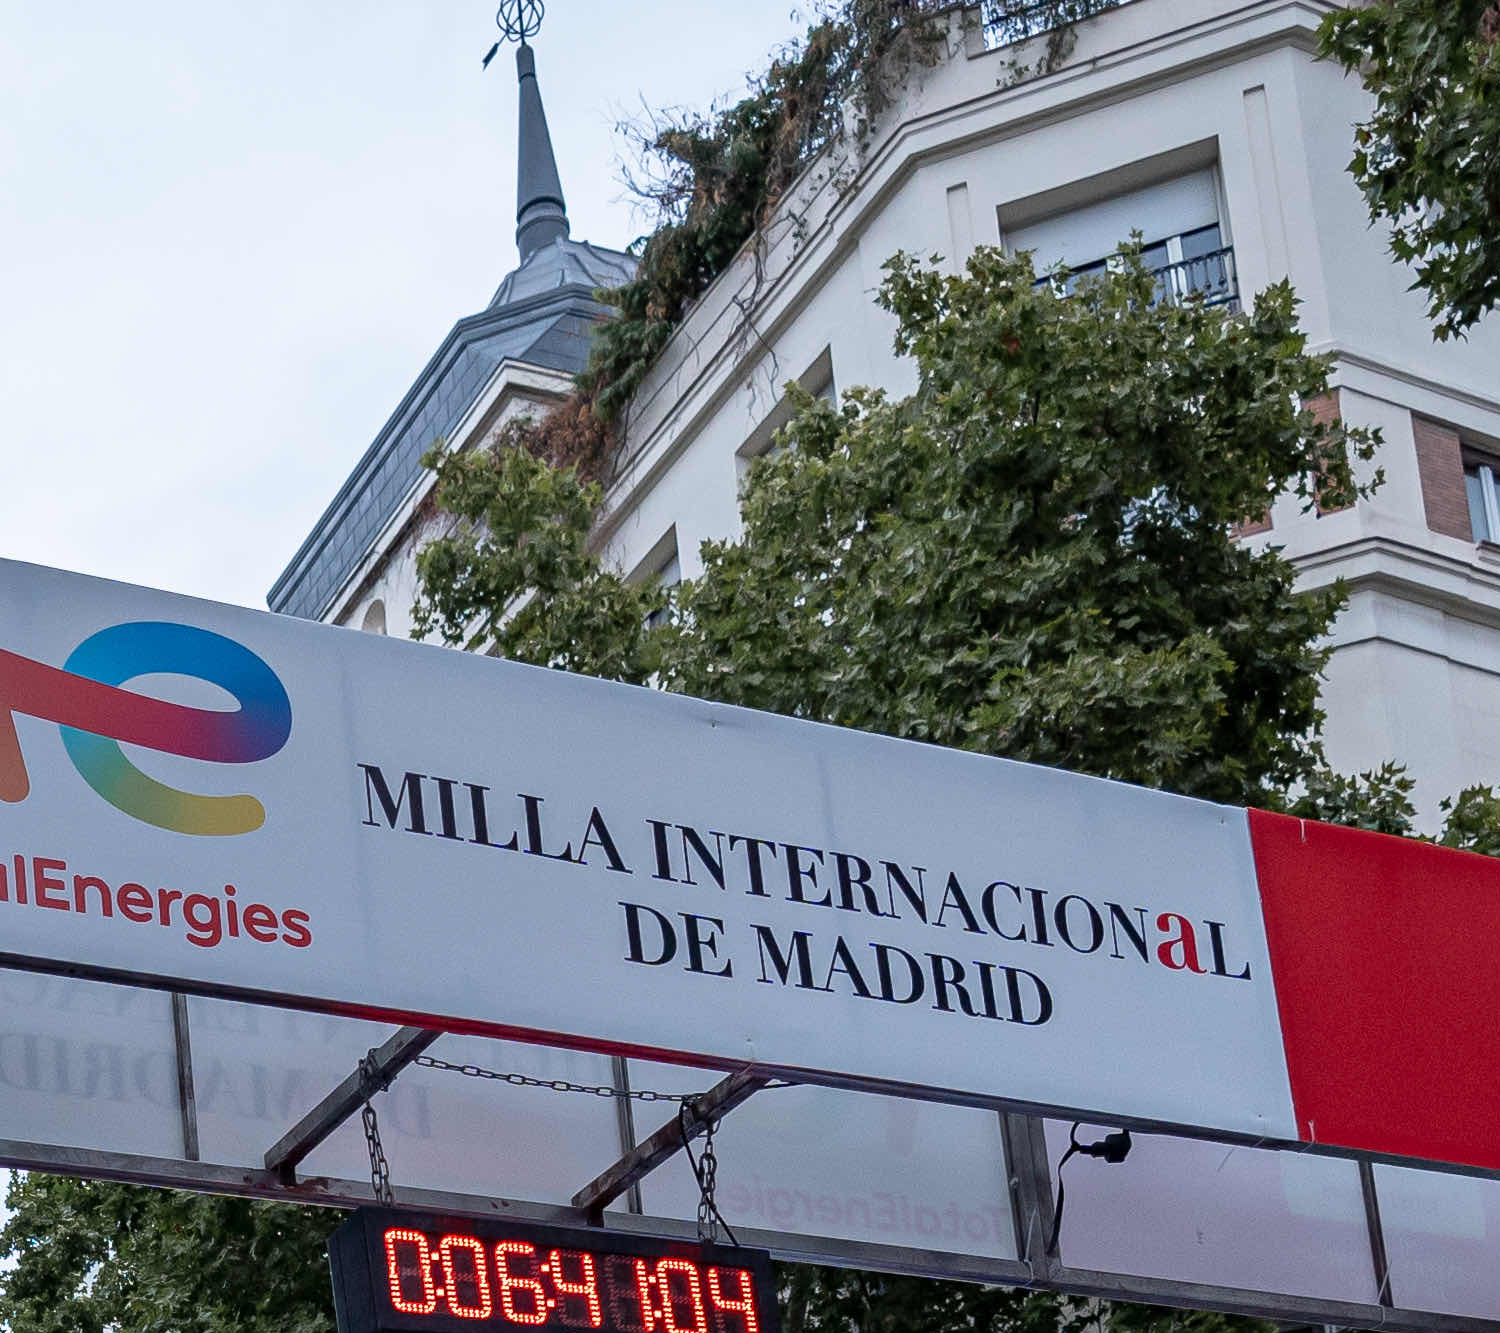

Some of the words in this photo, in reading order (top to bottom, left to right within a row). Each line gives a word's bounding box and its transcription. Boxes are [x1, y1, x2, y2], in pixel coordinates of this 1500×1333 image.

[356, 762, 632, 874] MILLA
[619, 901, 732, 977] DE
[751, 924, 1054, 1027] MADRID
